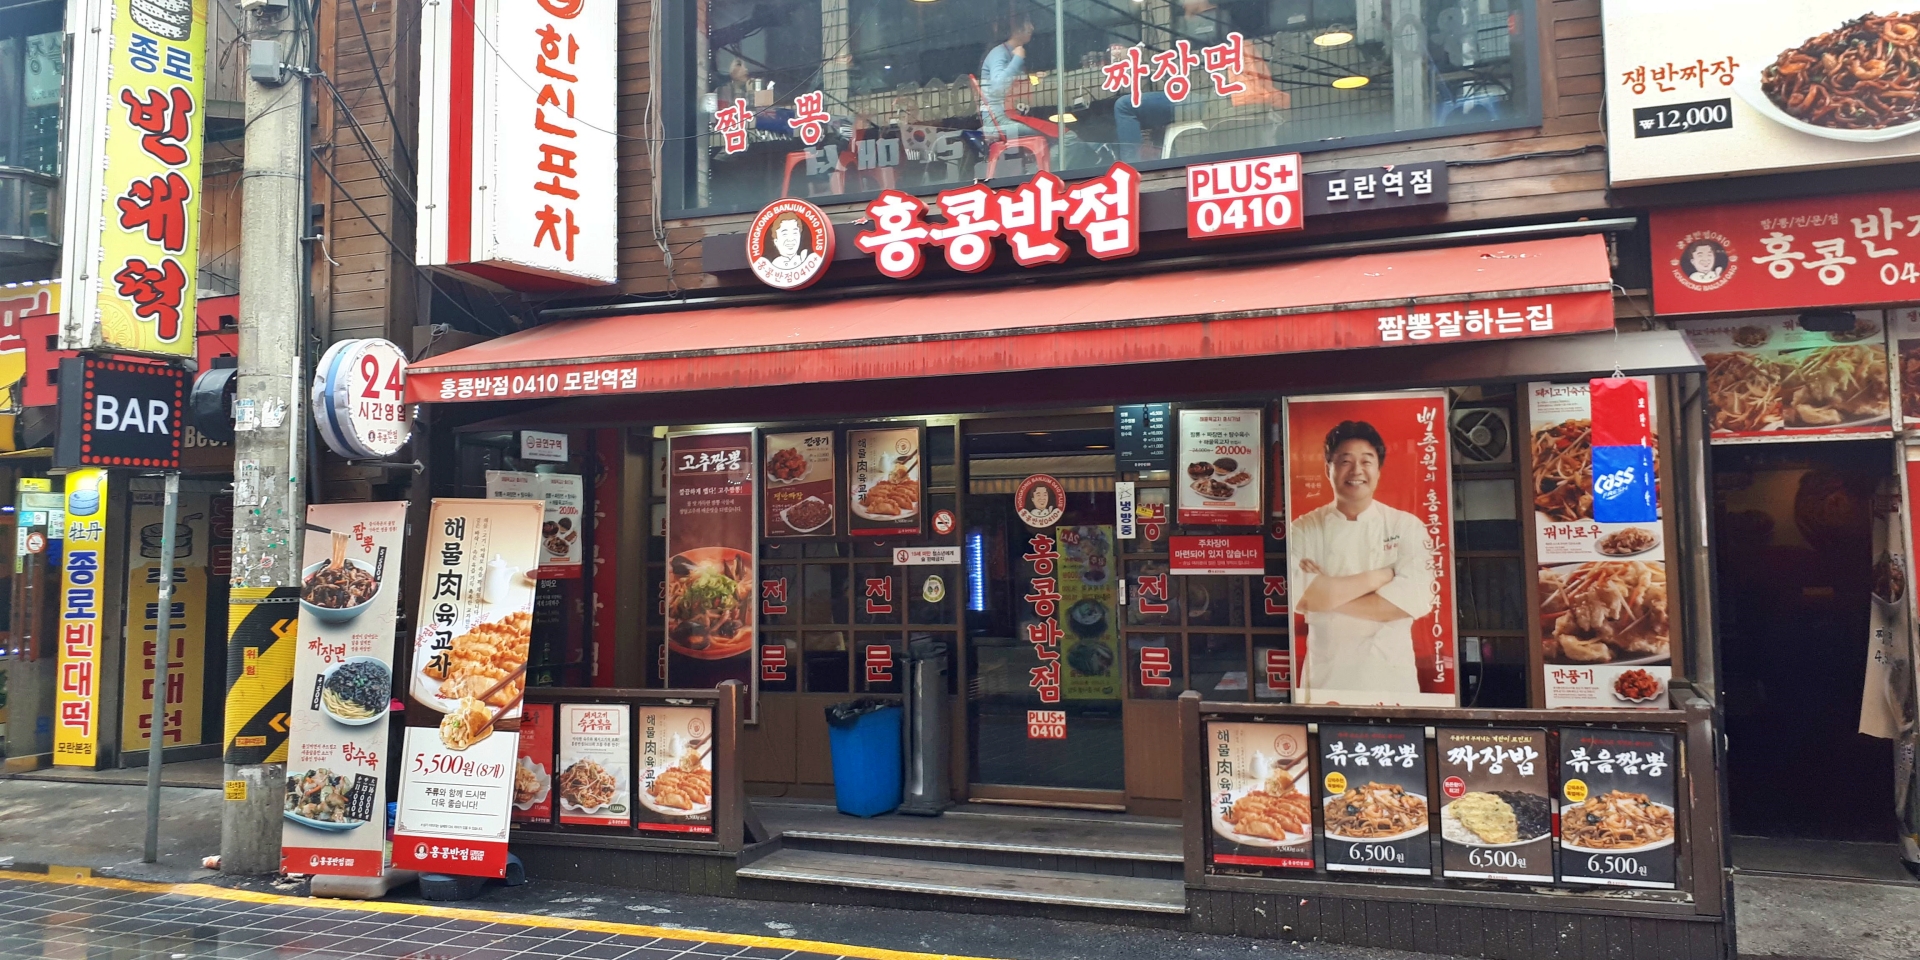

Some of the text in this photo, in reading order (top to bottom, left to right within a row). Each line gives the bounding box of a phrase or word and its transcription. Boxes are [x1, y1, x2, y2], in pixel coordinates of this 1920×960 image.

[128, 32, 194, 82] 종로
[1102, 32, 1248, 107] 짜장면
[1621, 56, 1740, 95] 쟁반짜장
[714, 90, 830, 154] 짬 뽕
[533, 23, 580, 262] 한신포차
[1192, 162, 1294, 199] PLUS+
[1326, 166, 1434, 202] 모란역점
[115, 87, 194, 343] 빈대떡
[857, 164, 1138, 278] 홍콩반점
[1196, 193, 1292, 233] 0410
[752, 203, 824, 257] HONGKONG BANJUM 0410 PLUS
[1377, 302, 1554, 342] 짬뽕잘하는집
[361, 354, 403, 400] 24
[439, 367, 637, 399] 홍콩반점 0410 모란역점
[96, 395, 170, 435] BAR
[359, 402, 406, 422] 시간영업
[535, 438, 562, 450] 금연구역
[1215, 446, 1251, 455] 20,000원
[679, 450, 741, 472] 고추짬뽕
[1594, 467, 1635, 494] Cass
[1603, 485, 1629, 499] FRESH
[68, 520, 103, 542] 牡丹
[1119, 501, 1132, 536] 냉방중
[1543, 524, 1603, 540] 꿔바로우
[353, 522, 375, 553] 짬뽕
[1198, 539, 1230, 548] 주차장이
[1174, 549, 1257, 558] 마련되어 있지 않습니다
[1022, 533, 1065, 703] 홍콩반점
[61, 550, 99, 737] 종로빈대떡
[308, 636, 347, 664] 짜장면
[1551, 669, 1594, 684] 깐풍기
[577, 718, 612, 732] 숙주볶음
[1028, 711, 1064, 723] PLUS+
[1030, 725, 1064, 738] 0410
[57, 741, 92, 754] 모란본점
[342, 741, 379, 771] 탕수육
[1325, 741, 1419, 768] 볶음짬뽕
[1447, 745, 1538, 775] 짜장밥
[412, 753, 505, 779] 5,500원 (8개)
[1566, 747, 1668, 777] 볶음짬뽕
[425, 787, 487, 800] 주류와 함께 드시면
[431, 798, 479, 810] 더욱 좋습니다!
[319, 857, 345, 866] 홍콩반점
[430, 846, 469, 860] 홍콩반점
[1349, 842, 1405, 863] 6,500원
[1469, 847, 1527, 868] 6,500원
[1587, 853, 1648, 876] 6,500원
